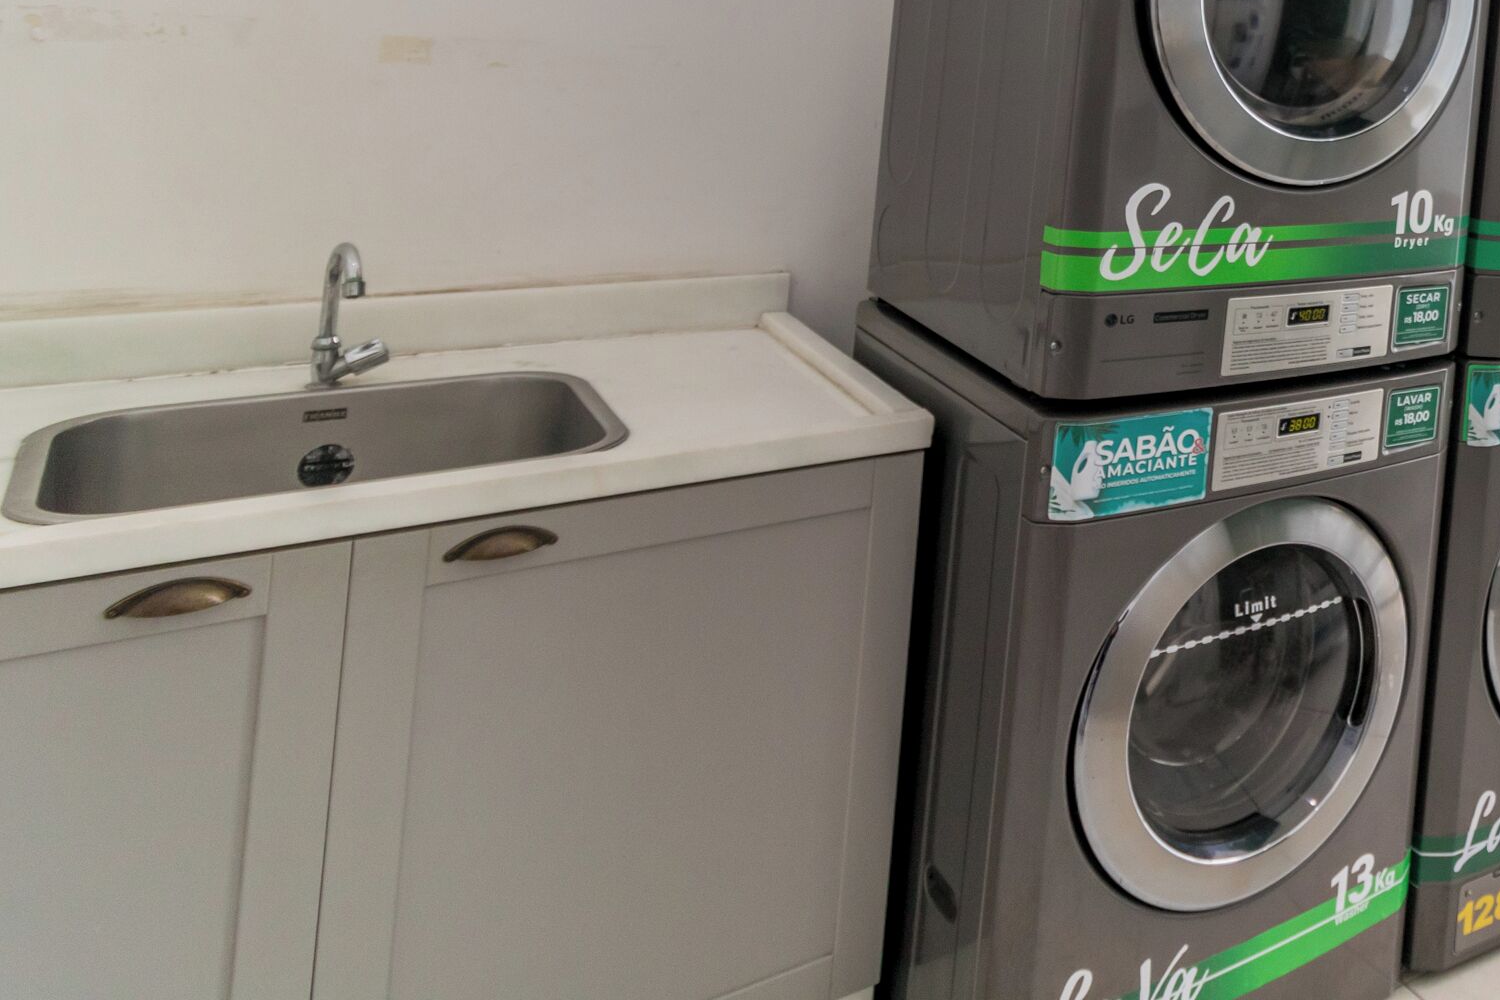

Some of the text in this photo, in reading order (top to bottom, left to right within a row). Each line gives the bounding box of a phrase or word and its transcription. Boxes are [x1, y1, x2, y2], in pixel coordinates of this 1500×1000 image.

[1100, 183, 1275, 281] SeCa
[1394, 236, 1430, 250] Dryer
[1406, 292, 1441, 305] SECAR
[1413, 309, 1439, 324] 18,00
[1397, 392, 1432, 407] LAVAR
[1403, 410, 1430, 425] 18,00
[1095, 425, 1200, 467] SABÃO
[1095, 454, 1198, 480] AMACIANTE
[1234, 595, 1278, 618] Limit
